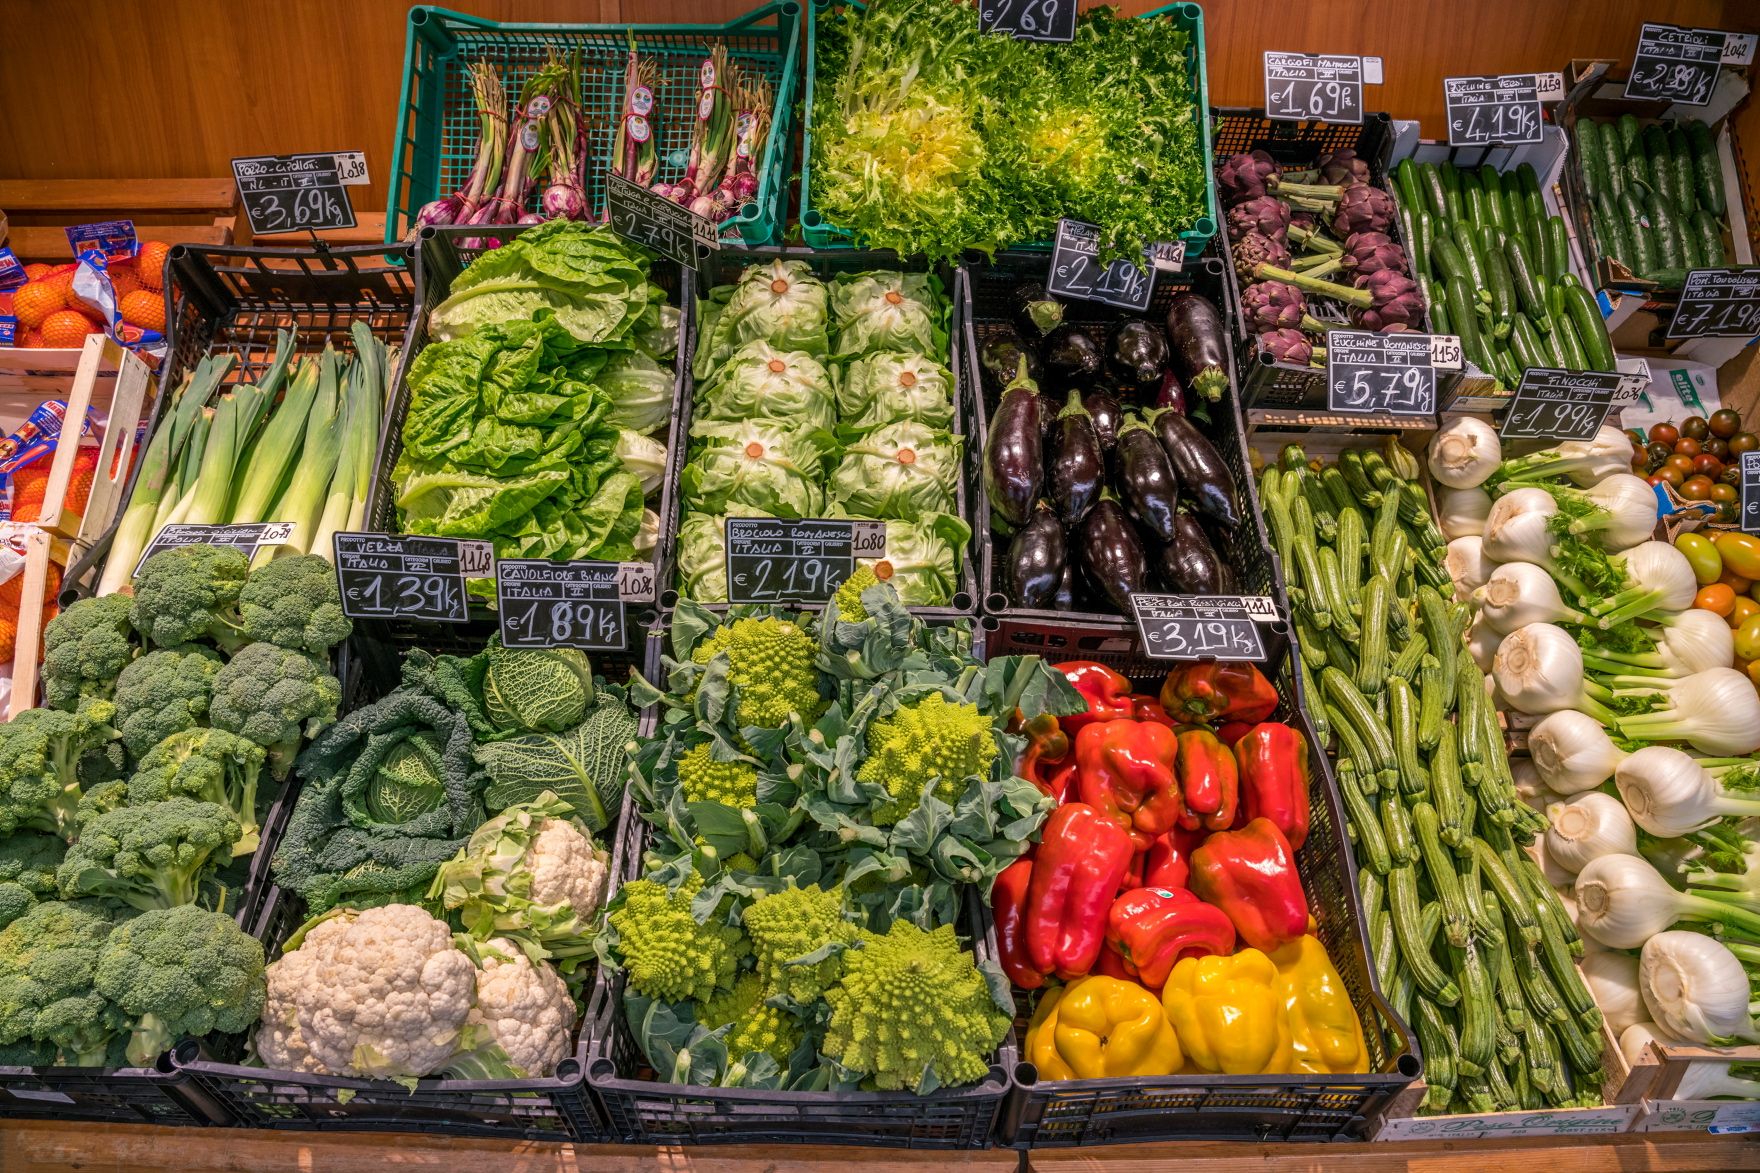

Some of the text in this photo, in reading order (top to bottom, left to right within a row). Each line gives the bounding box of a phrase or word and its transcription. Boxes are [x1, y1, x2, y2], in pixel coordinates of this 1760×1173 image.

[990, 0, 1058, 35] 2,69
[1658, 32, 1709, 44] CETRIOLI
[1643, 46, 1675, 55] ITALIA
[1722, 42, 1747, 58] 1042
[1269, 58, 1313, 66] CARCIOFI
[1271, 69, 1307, 77] ITALIA
[1536, 79, 1561, 93] 1159
[1280, 81, 1341, 116] 1,69
[1461, 94, 1484, 104] ITALIA
[1465, 104, 1522, 141] 4,19
[260, 189, 324, 229] 3,69
[623, 199, 648, 214] ITALIA
[625, 213, 674, 254] 2,79
[693, 222, 716, 242] 1111
[1066, 256, 1136, 294] 2,19
[1687, 289, 1720, 299] ITALIA
[1686, 303, 1754, 333] 7,19
[1333, 338, 1380, 348] ZUCCHINE
[1337, 353, 1376, 362] ITALIA
[1431, 344, 1460, 363] 1158
[1345, 368, 1420, 407] 5,79
[1548, 376, 1602, 387] FINOCCHI
[1675, 374, 1693, 402] elite
[1537, 390, 1564, 398] ITALIA
[1517, 403, 1586, 434] 1,99
[732, 527, 852, 539] BROCCOLO ROMANESCO
[852, 531, 886, 550] 1080
[357, 542, 403, 553] VERZA
[735, 543, 782, 554] ITALIA
[347, 558, 388, 569] ITALIA
[750, 559, 822, 599] 2,19
[363, 574, 444, 616] 1,39
[507, 587, 553, 597] ITALIA
[1152, 610, 1183, 618] ITALIA
[518, 601, 594, 645] 1,89
[1163, 622, 1227, 654] 3,19
